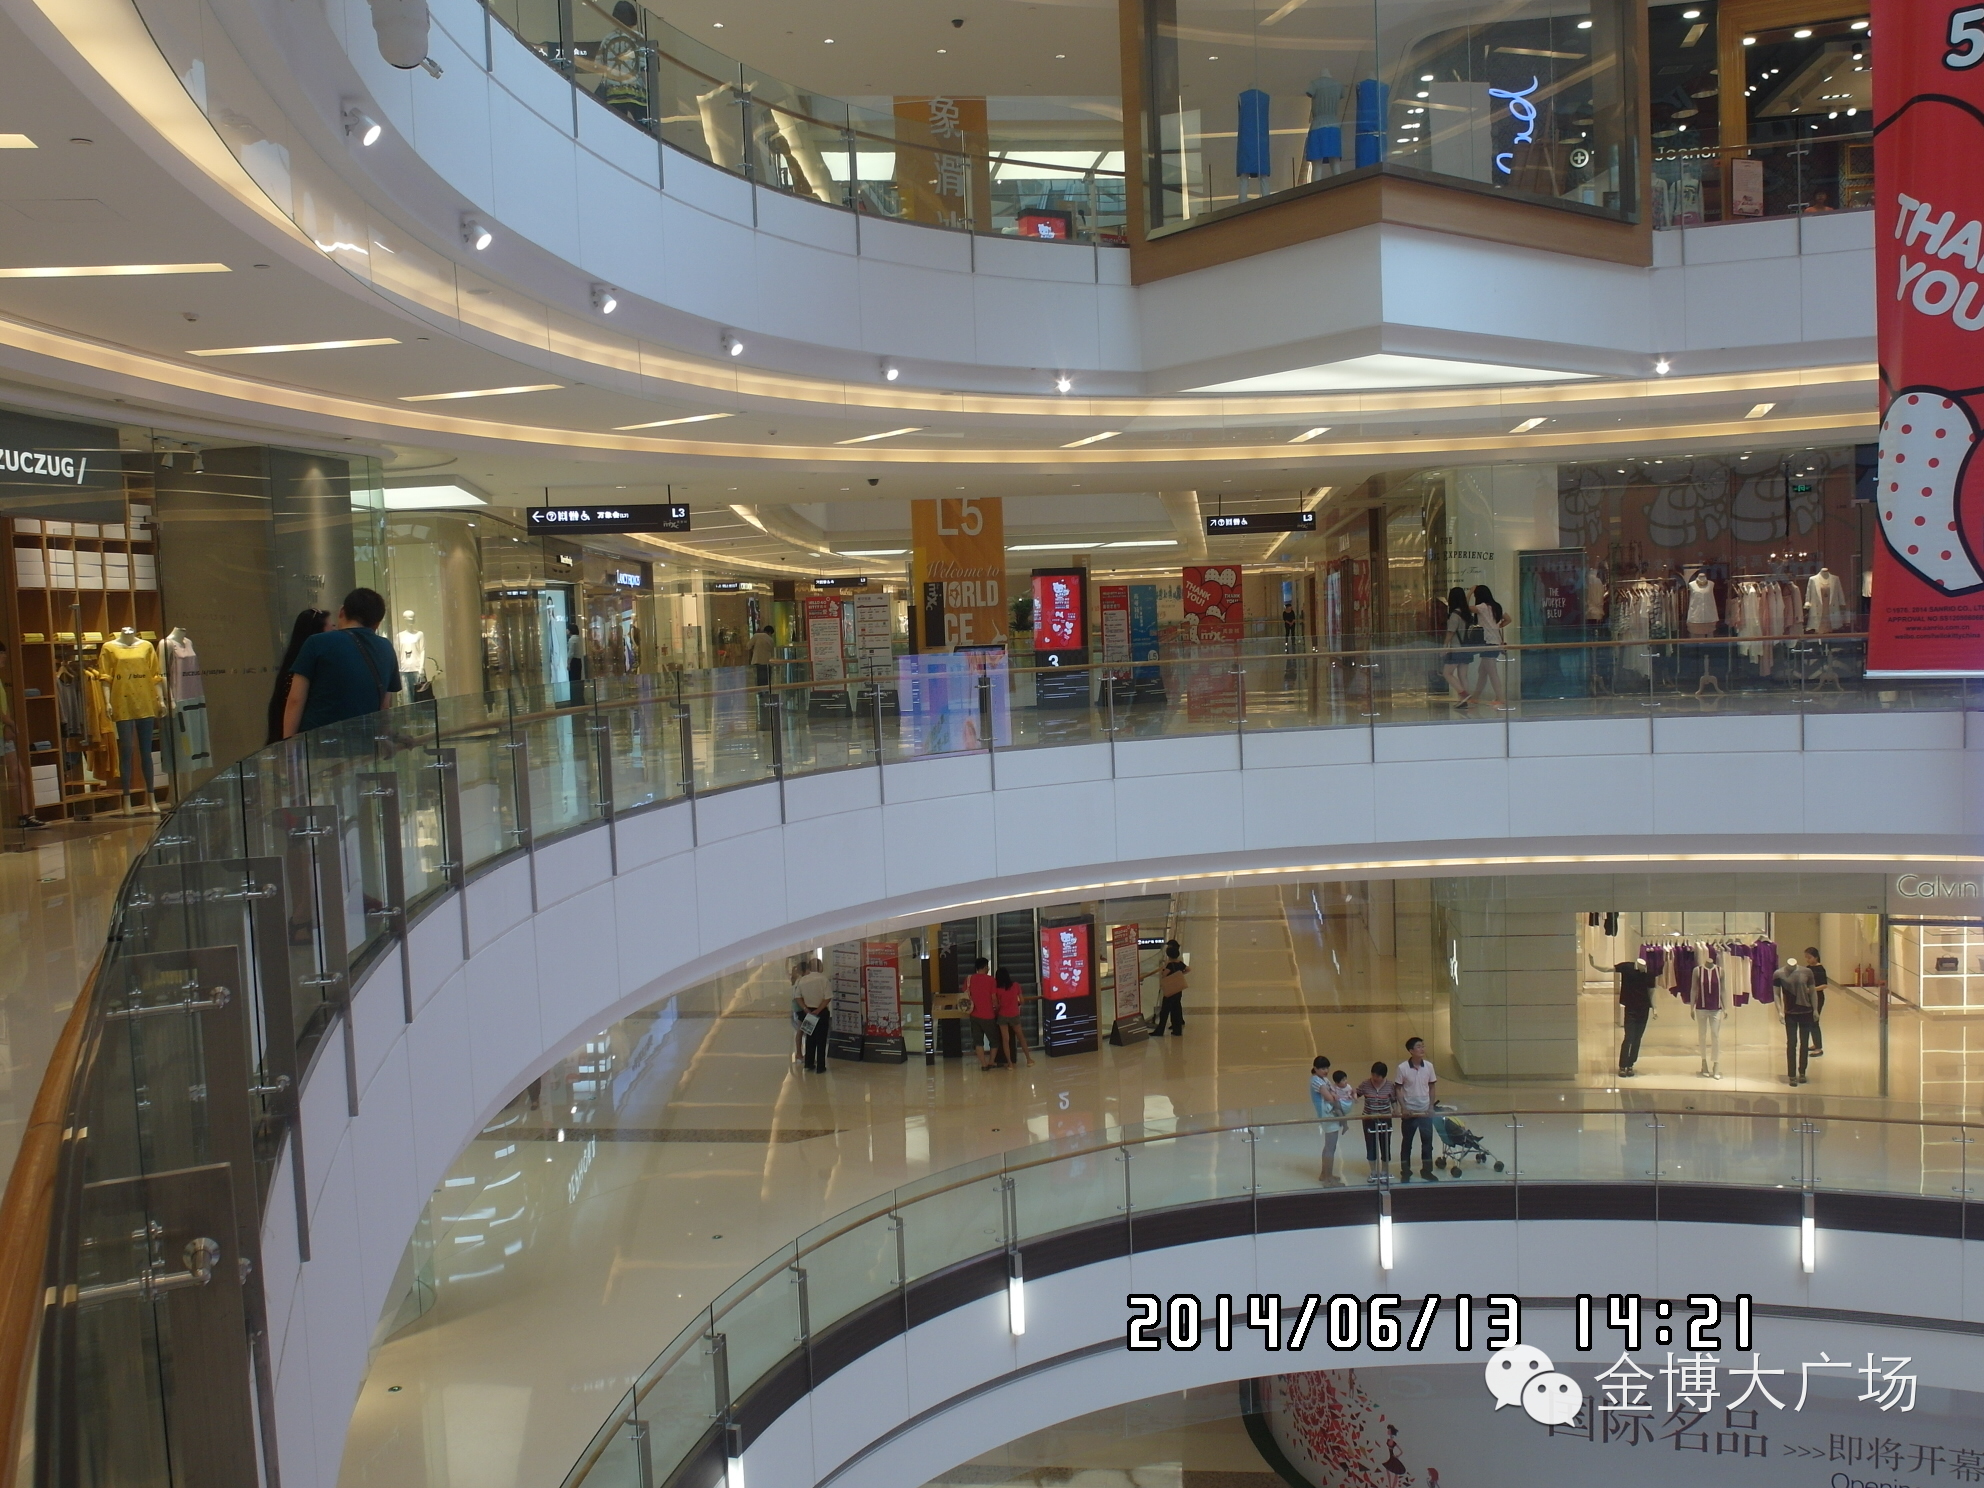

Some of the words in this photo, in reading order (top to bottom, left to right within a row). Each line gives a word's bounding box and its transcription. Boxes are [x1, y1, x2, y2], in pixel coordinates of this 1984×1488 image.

[671, 507, 686, 518] L3
[936, 497, 984, 536] L5
[1303, 514, 1313, 522] L3
[1443, 551, 1495, 561] EXPERIENCE
[927, 560, 985, 579] Welcome
[986, 565, 1000, 577] to
[1186, 580, 1211, 601] THANK
[1548, 587, 1559, 597] THE
[1186, 590, 1205, 607] YOU!
[1541, 597, 1567, 608] WORKER
[1546, 608, 1562, 619] BLEU
[1929, 605, 1956, 613] SANRIO
[945, 613, 974, 646] CE
[1048, 654, 1060, 667] 3
[1896, 873, 1978, 898] Calvin
[1055, 1002, 1067, 1020] 2
[1828, 1432, 1984, 1483] 即将开幕
